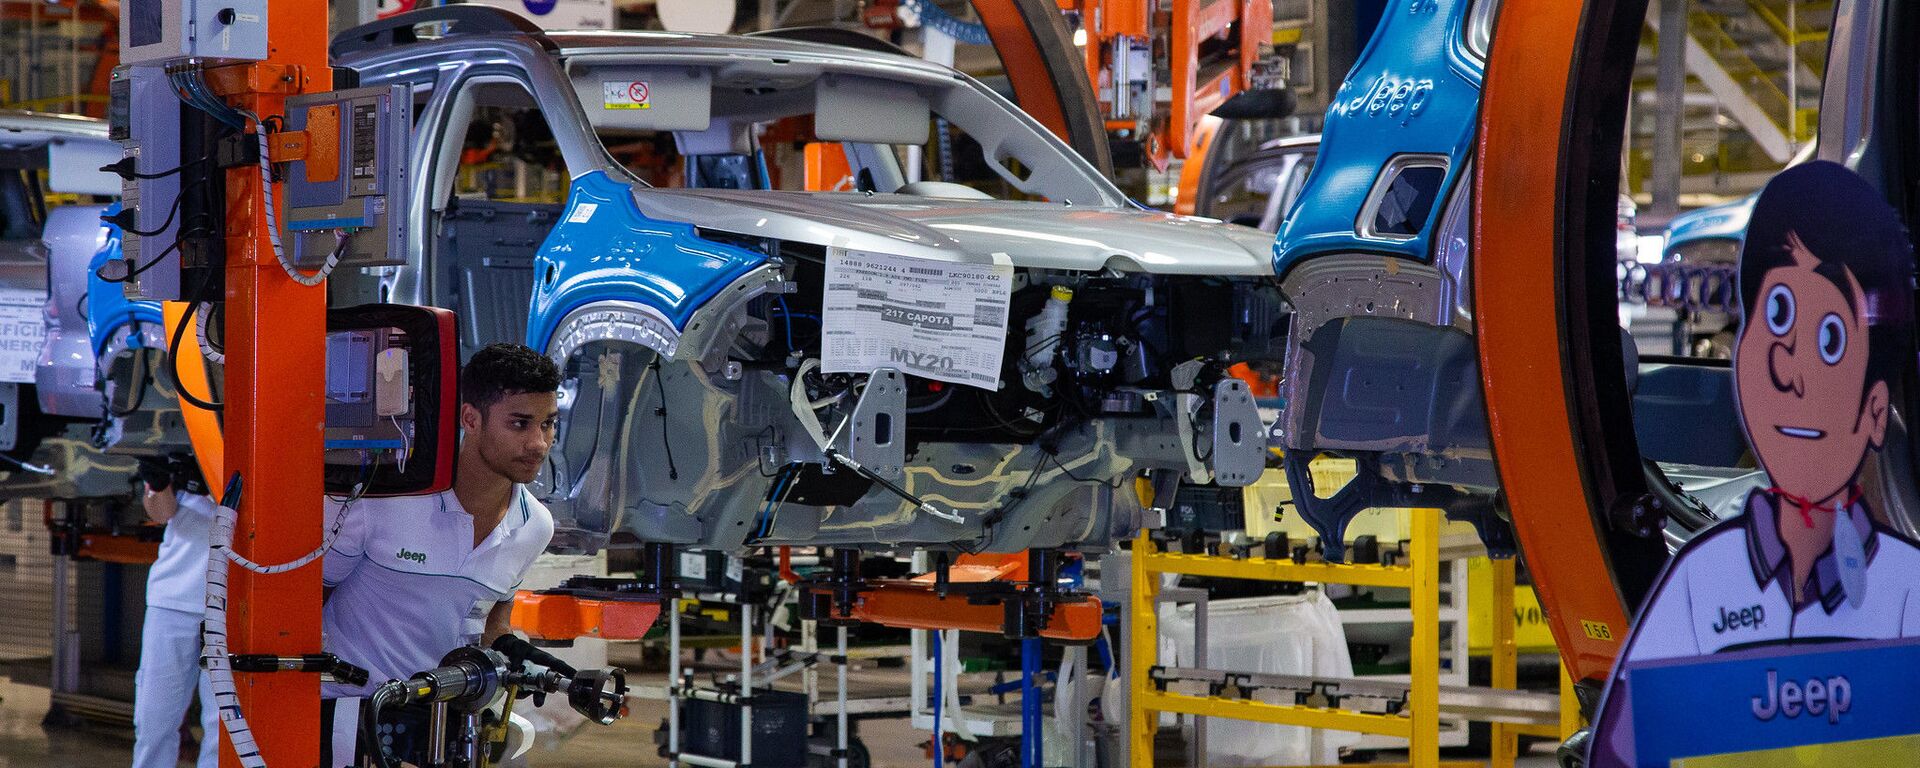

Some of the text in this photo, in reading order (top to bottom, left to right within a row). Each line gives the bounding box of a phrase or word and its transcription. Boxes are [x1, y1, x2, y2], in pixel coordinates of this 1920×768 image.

[1349, 72, 1434, 128] Jeep
[885, 308, 904, 318] 217
[906, 312, 950, 325] CAPOTA
[890, 346, 954, 371] MY20
[396, 548, 427, 564] Jeep
[1584, 623, 1610, 639] 156
[1712, 604, 1766, 634] Jeep
[1751, 670, 1851, 725] Jeep
